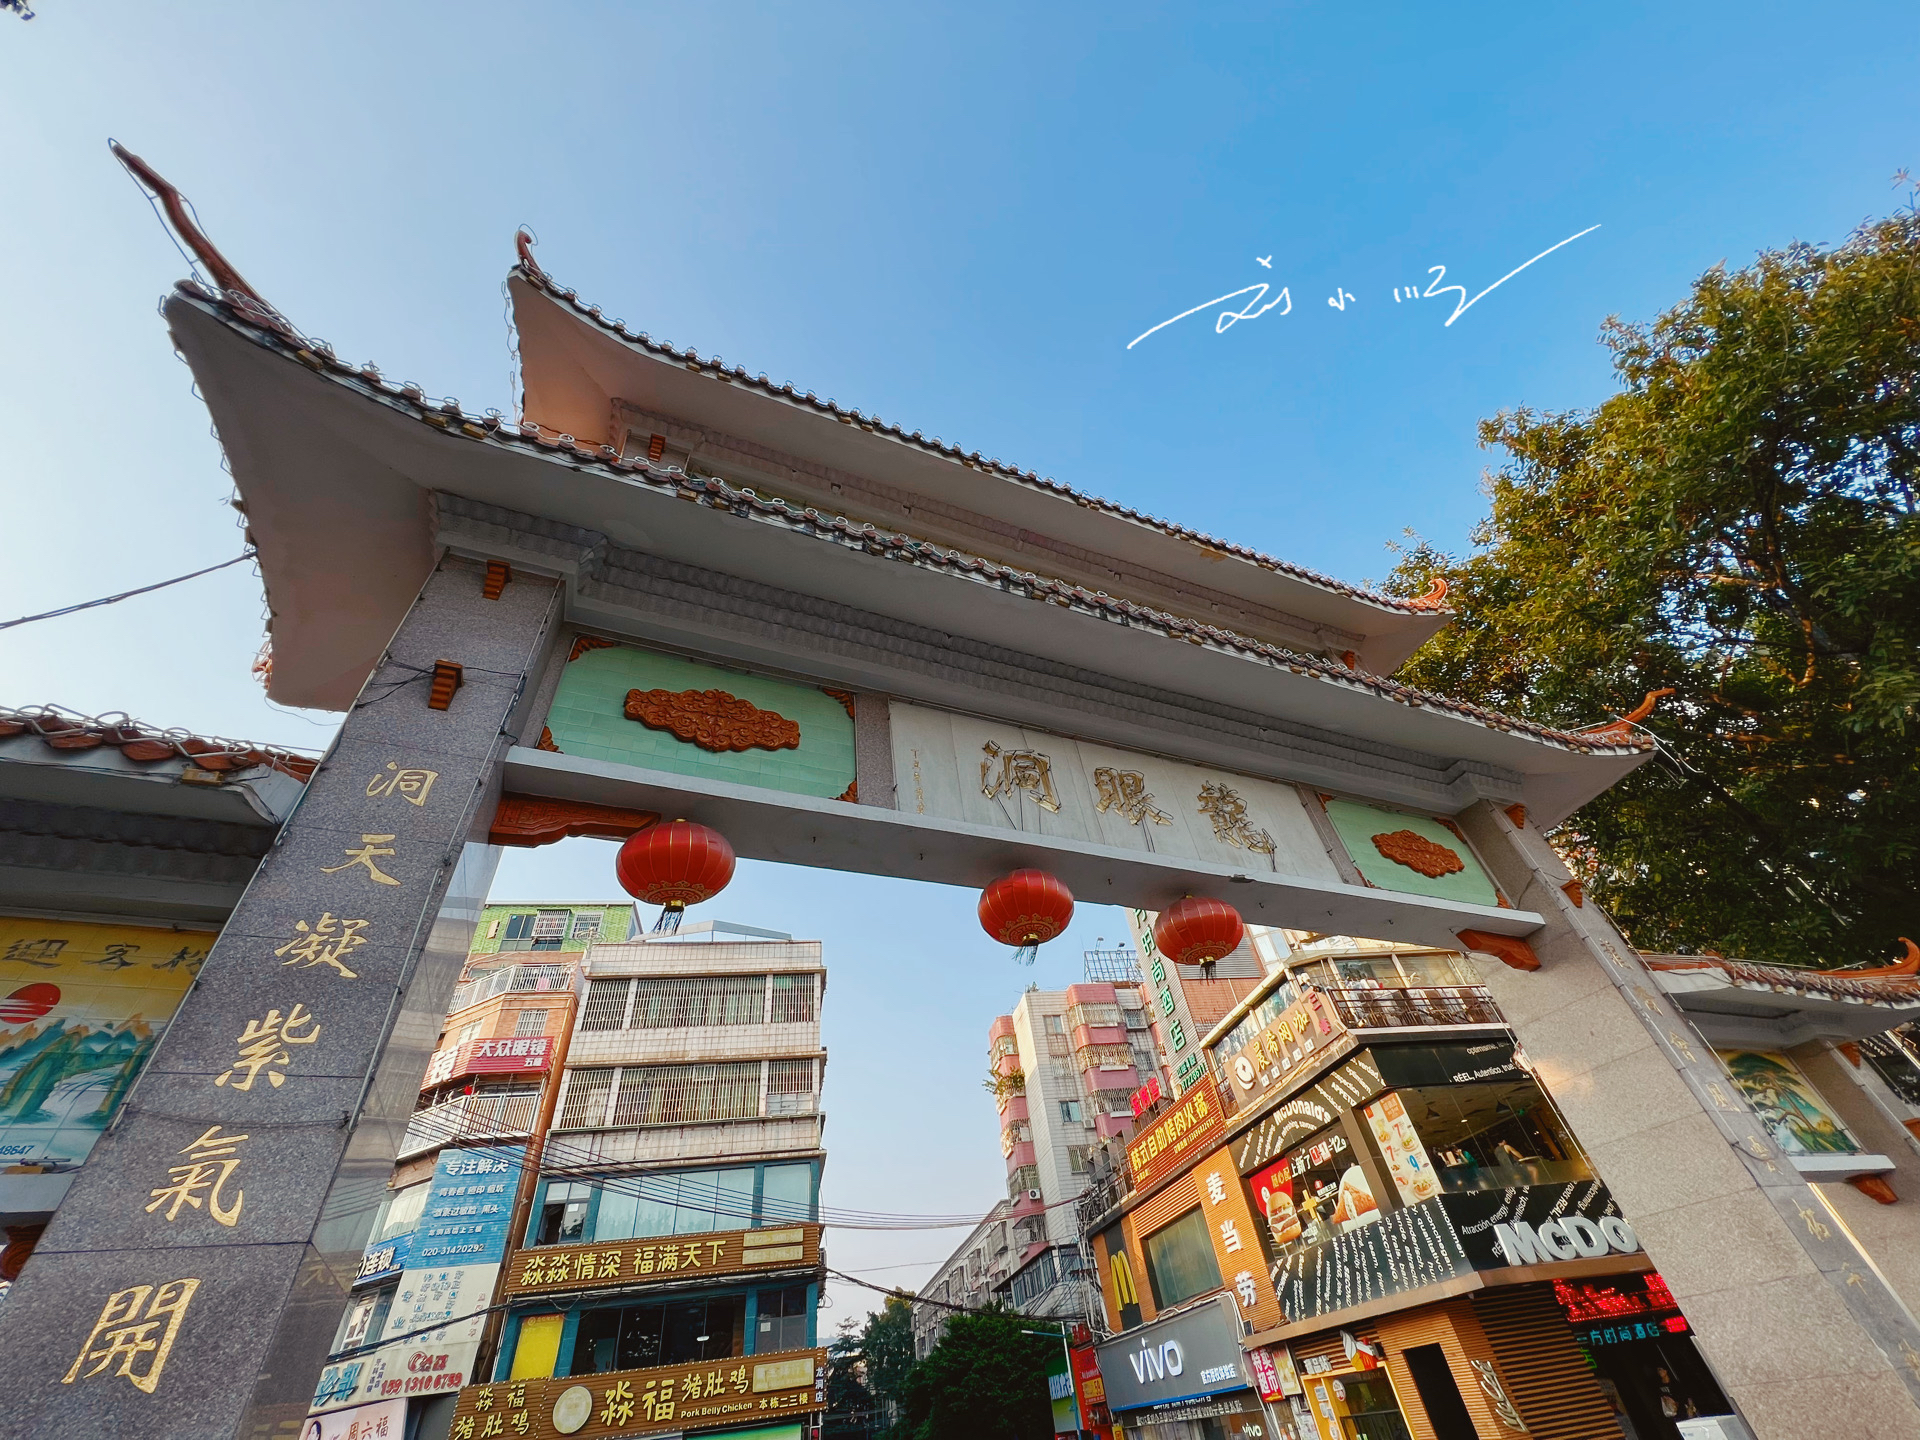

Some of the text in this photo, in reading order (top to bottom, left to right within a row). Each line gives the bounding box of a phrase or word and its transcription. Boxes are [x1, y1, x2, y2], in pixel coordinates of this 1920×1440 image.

[477, 1039, 548, 1058] 大众眼镜
[445, 1159, 510, 1176] 专注解决
[421, 1243, 486, 1258] 020-31420292
[1205, 1172, 1257, 1308] 麦当劳
[520, 1250, 622, 1287] 淼淼情深
[633, 1240, 727, 1275] 福满天下
[1129, 1337, 1184, 1385] vivo
[1250, 1346, 1274, 1373] 特卖
[600, 1379, 676, 1427] 淼福
[681, 1364, 749, 1402] 猪肚鸡
[815, 1367, 825, 1403] 龙洞店
[1257, 1369, 1281, 1395] 超市
[680, 1401, 753, 1419] Pork Belly Chicken
[454, 1408, 530, 1440] 猪肚鸡
[1242, 1422, 1263, 1438] vivo
